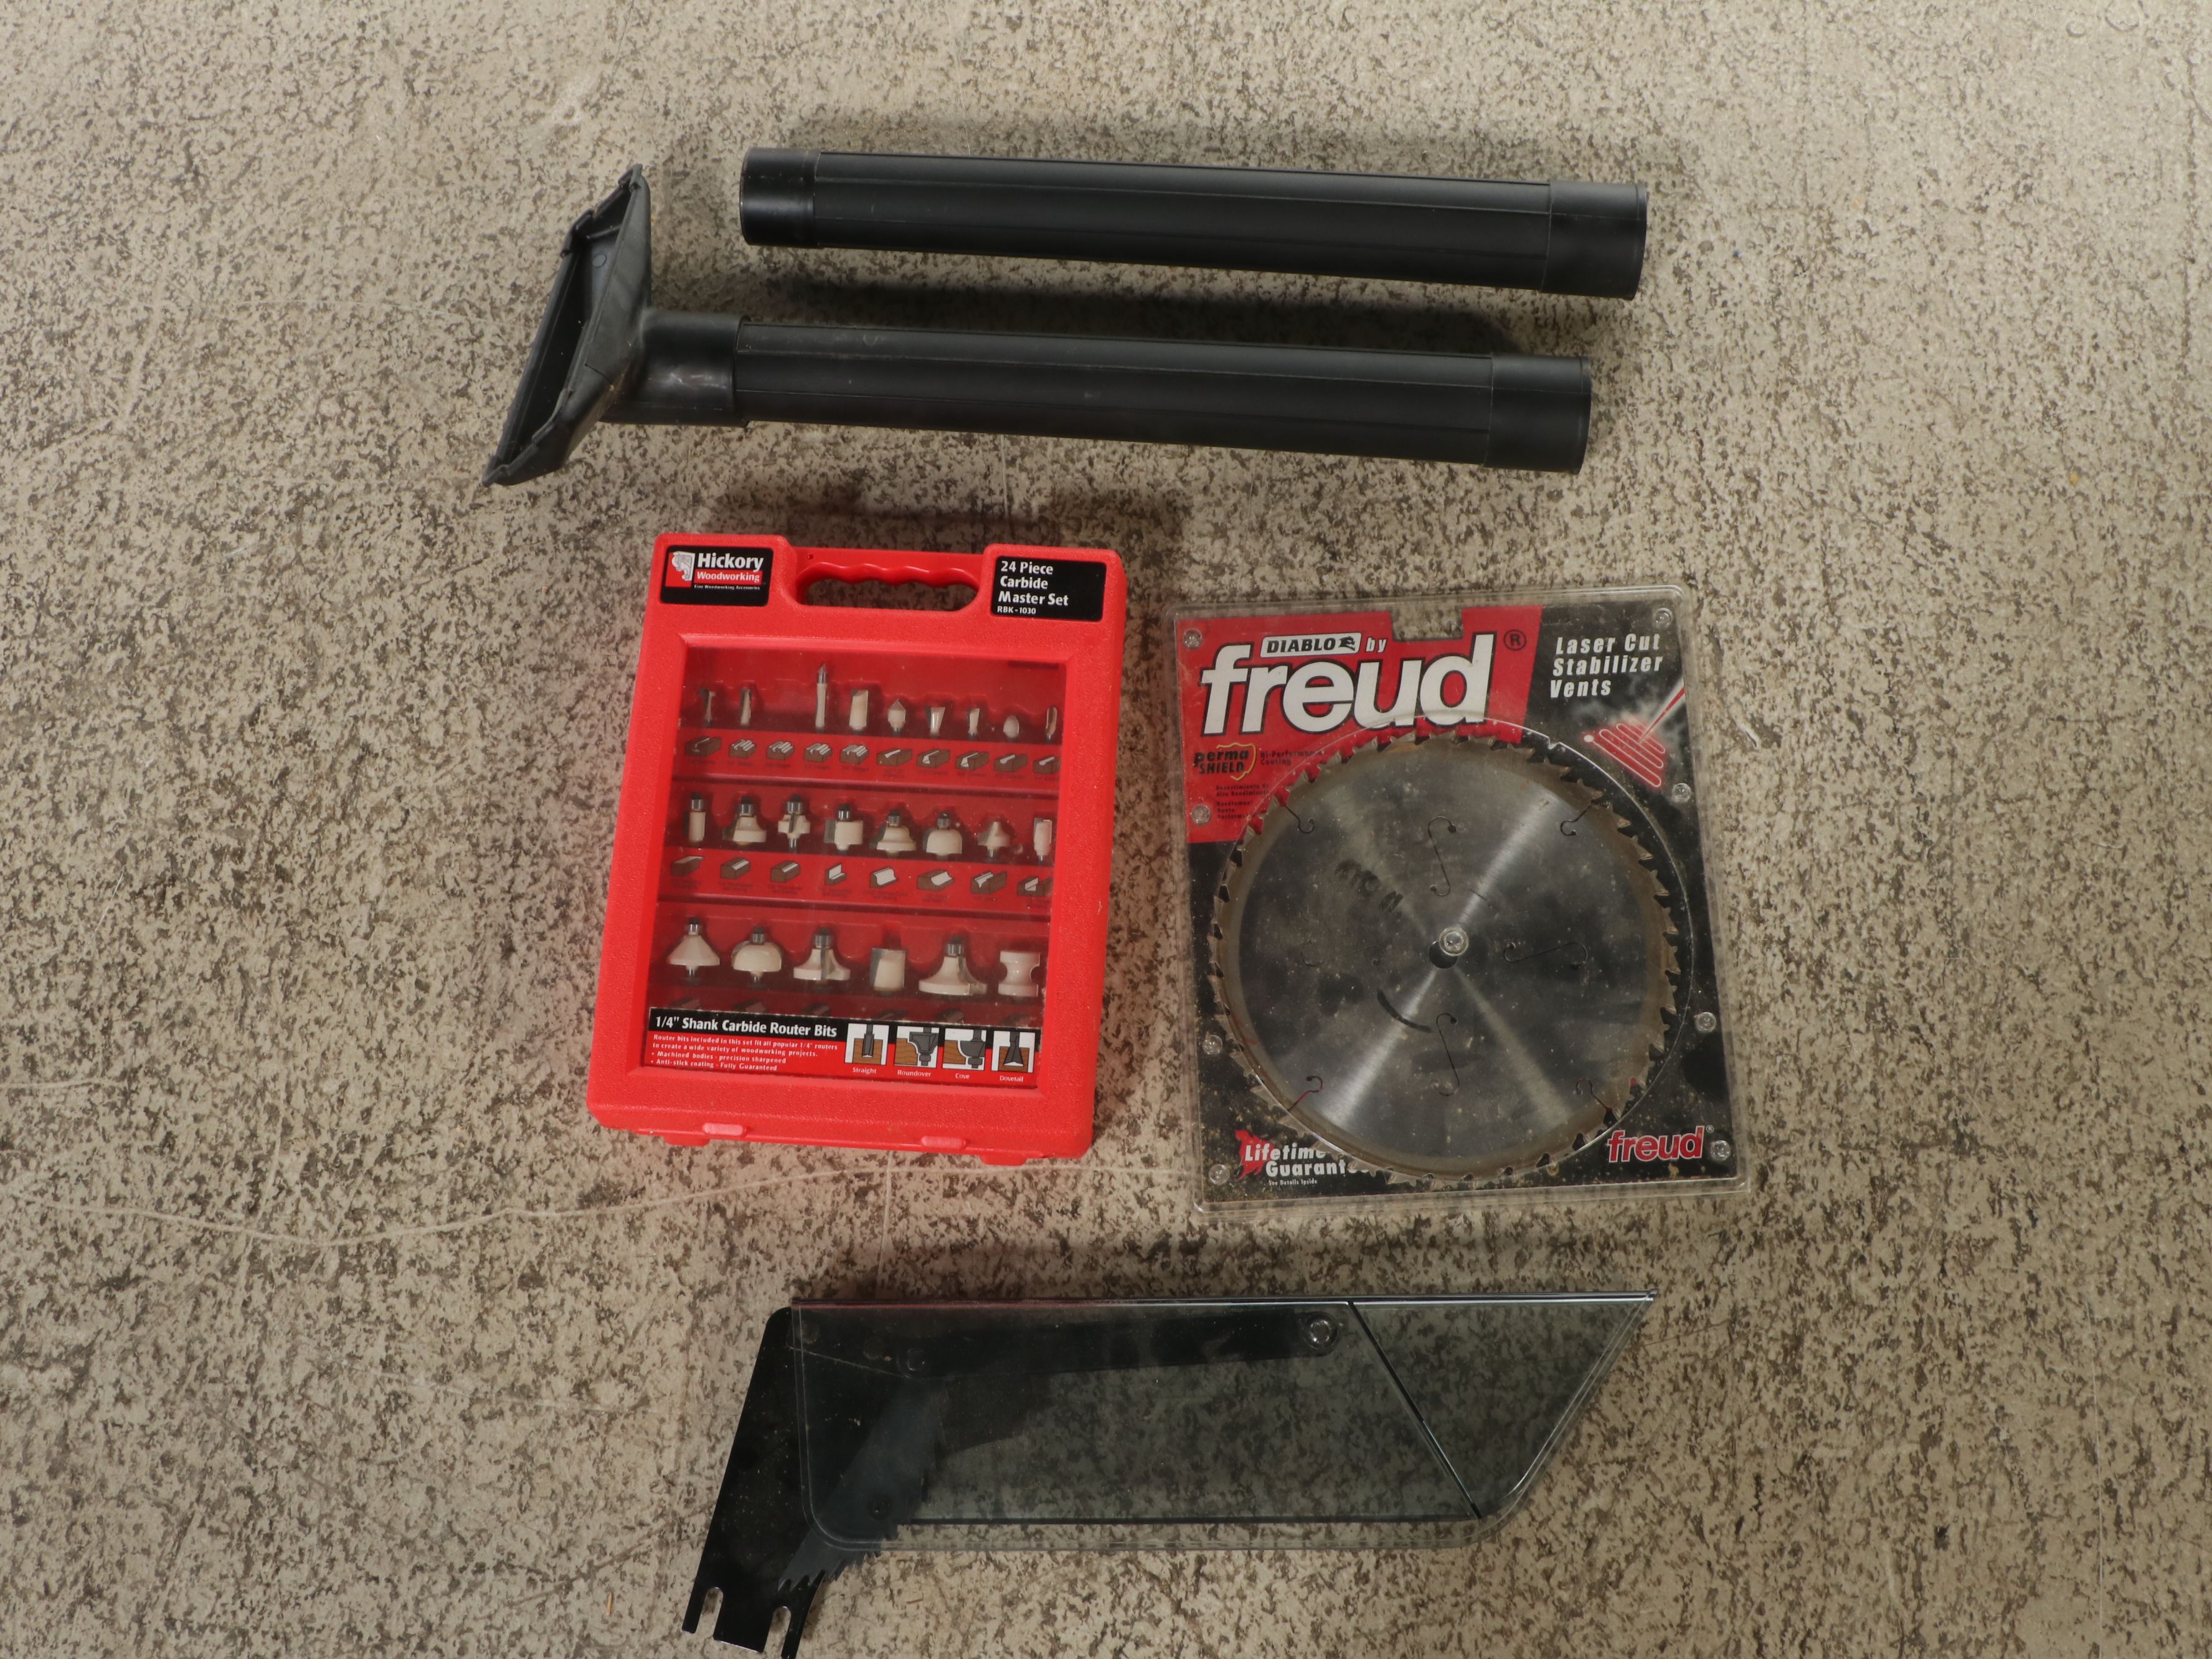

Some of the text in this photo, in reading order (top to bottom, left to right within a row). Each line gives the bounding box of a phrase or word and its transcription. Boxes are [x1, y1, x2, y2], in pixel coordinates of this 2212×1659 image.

[697, 552, 764, 572] Hickory
[1000, 560, 1054, 575] 24 Piece
[696, 571, 760, 582] Woodworking
[1000, 575, 1049, 589] Carbide
[998, 591, 1069, 606] Master Set
[1267, 637, 1387, 653] DIABLO by
[1556, 633, 1660, 655] Laser Cut
[1553, 655, 1663, 676] Stabilizer
[1201, 633, 1496, 735] freud
[1550, 679, 1612, 698] Vents
[1194, 750, 1249, 765] perma
[1199, 762, 1244, 774] SHIELD
[656, 1016, 838, 1037] 1/4" Shank Carbide Router Bits
[741, 1047, 786, 1056] woodworking
[691, 1061, 714, 1069] coating
[897, 1069, 932, 1077] Roundover
[1607, 1125, 1704, 1163] freud
[1266, 1159, 1369, 1177] Guarant
